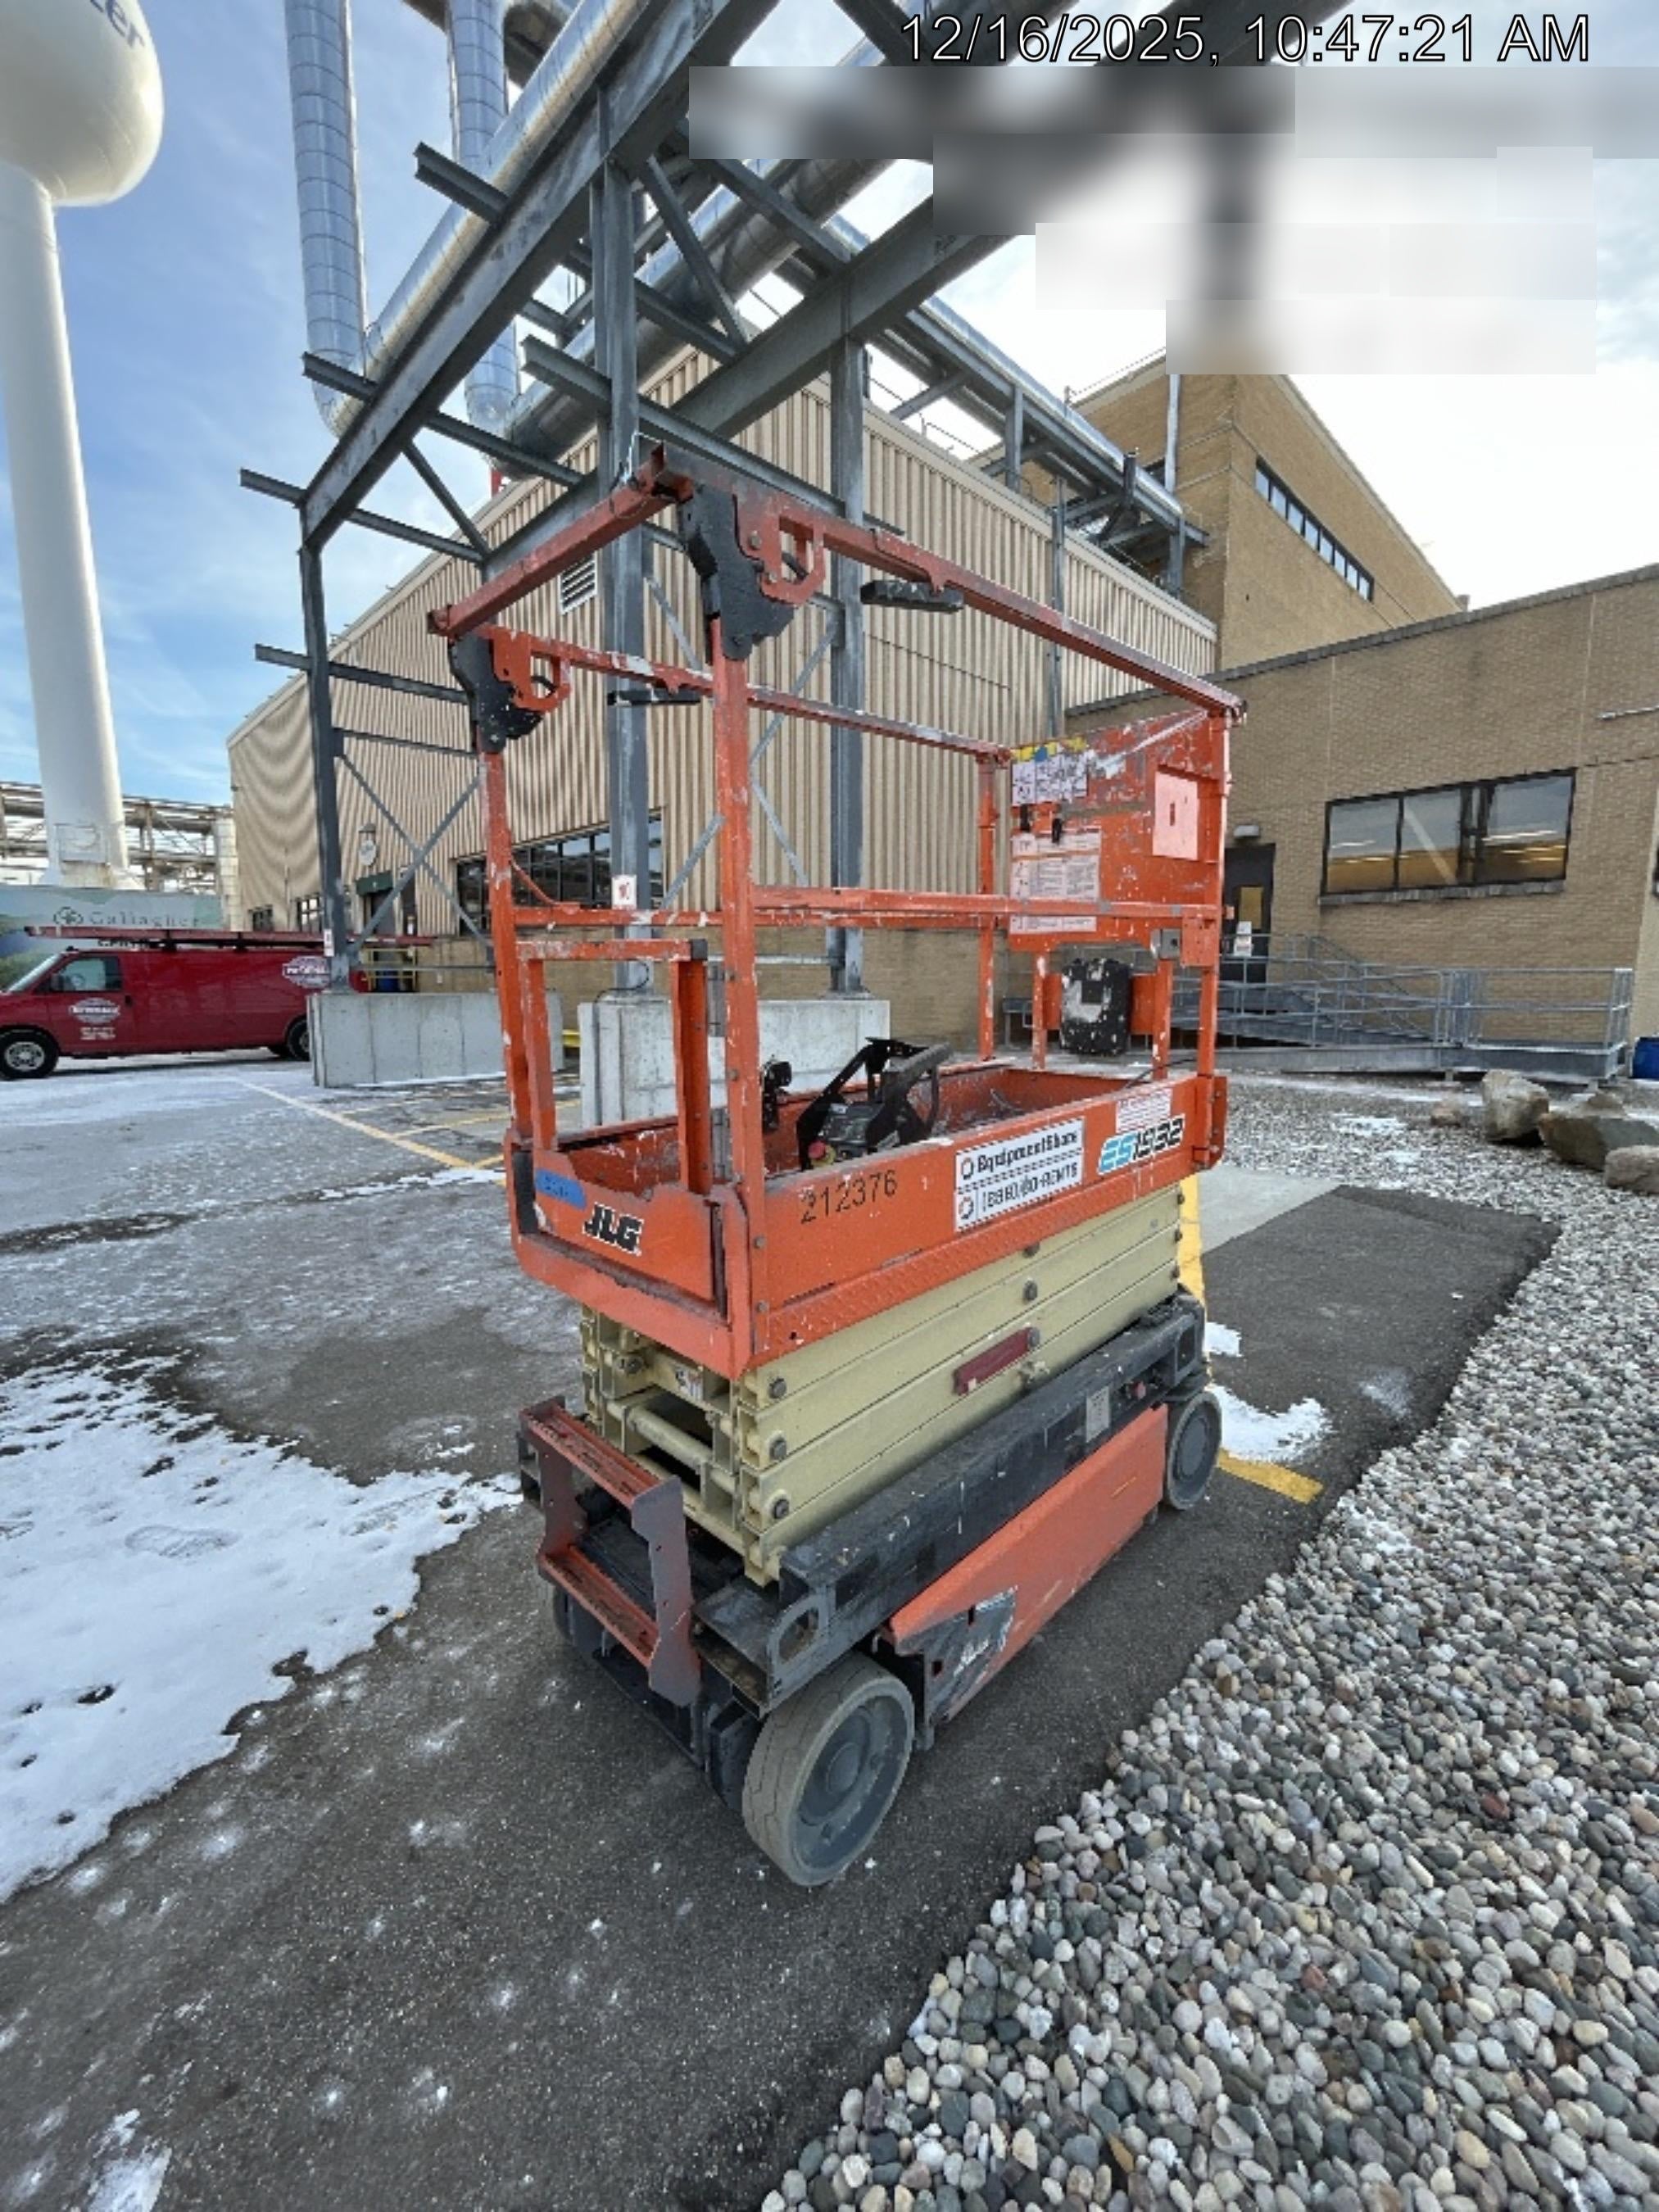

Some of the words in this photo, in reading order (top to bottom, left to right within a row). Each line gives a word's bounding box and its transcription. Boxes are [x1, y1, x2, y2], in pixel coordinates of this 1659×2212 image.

[90, 911, 198, 927] Gallagher
[800, 1169, 898, 1224] 212376
[582, 1202, 644, 1254] JLG
